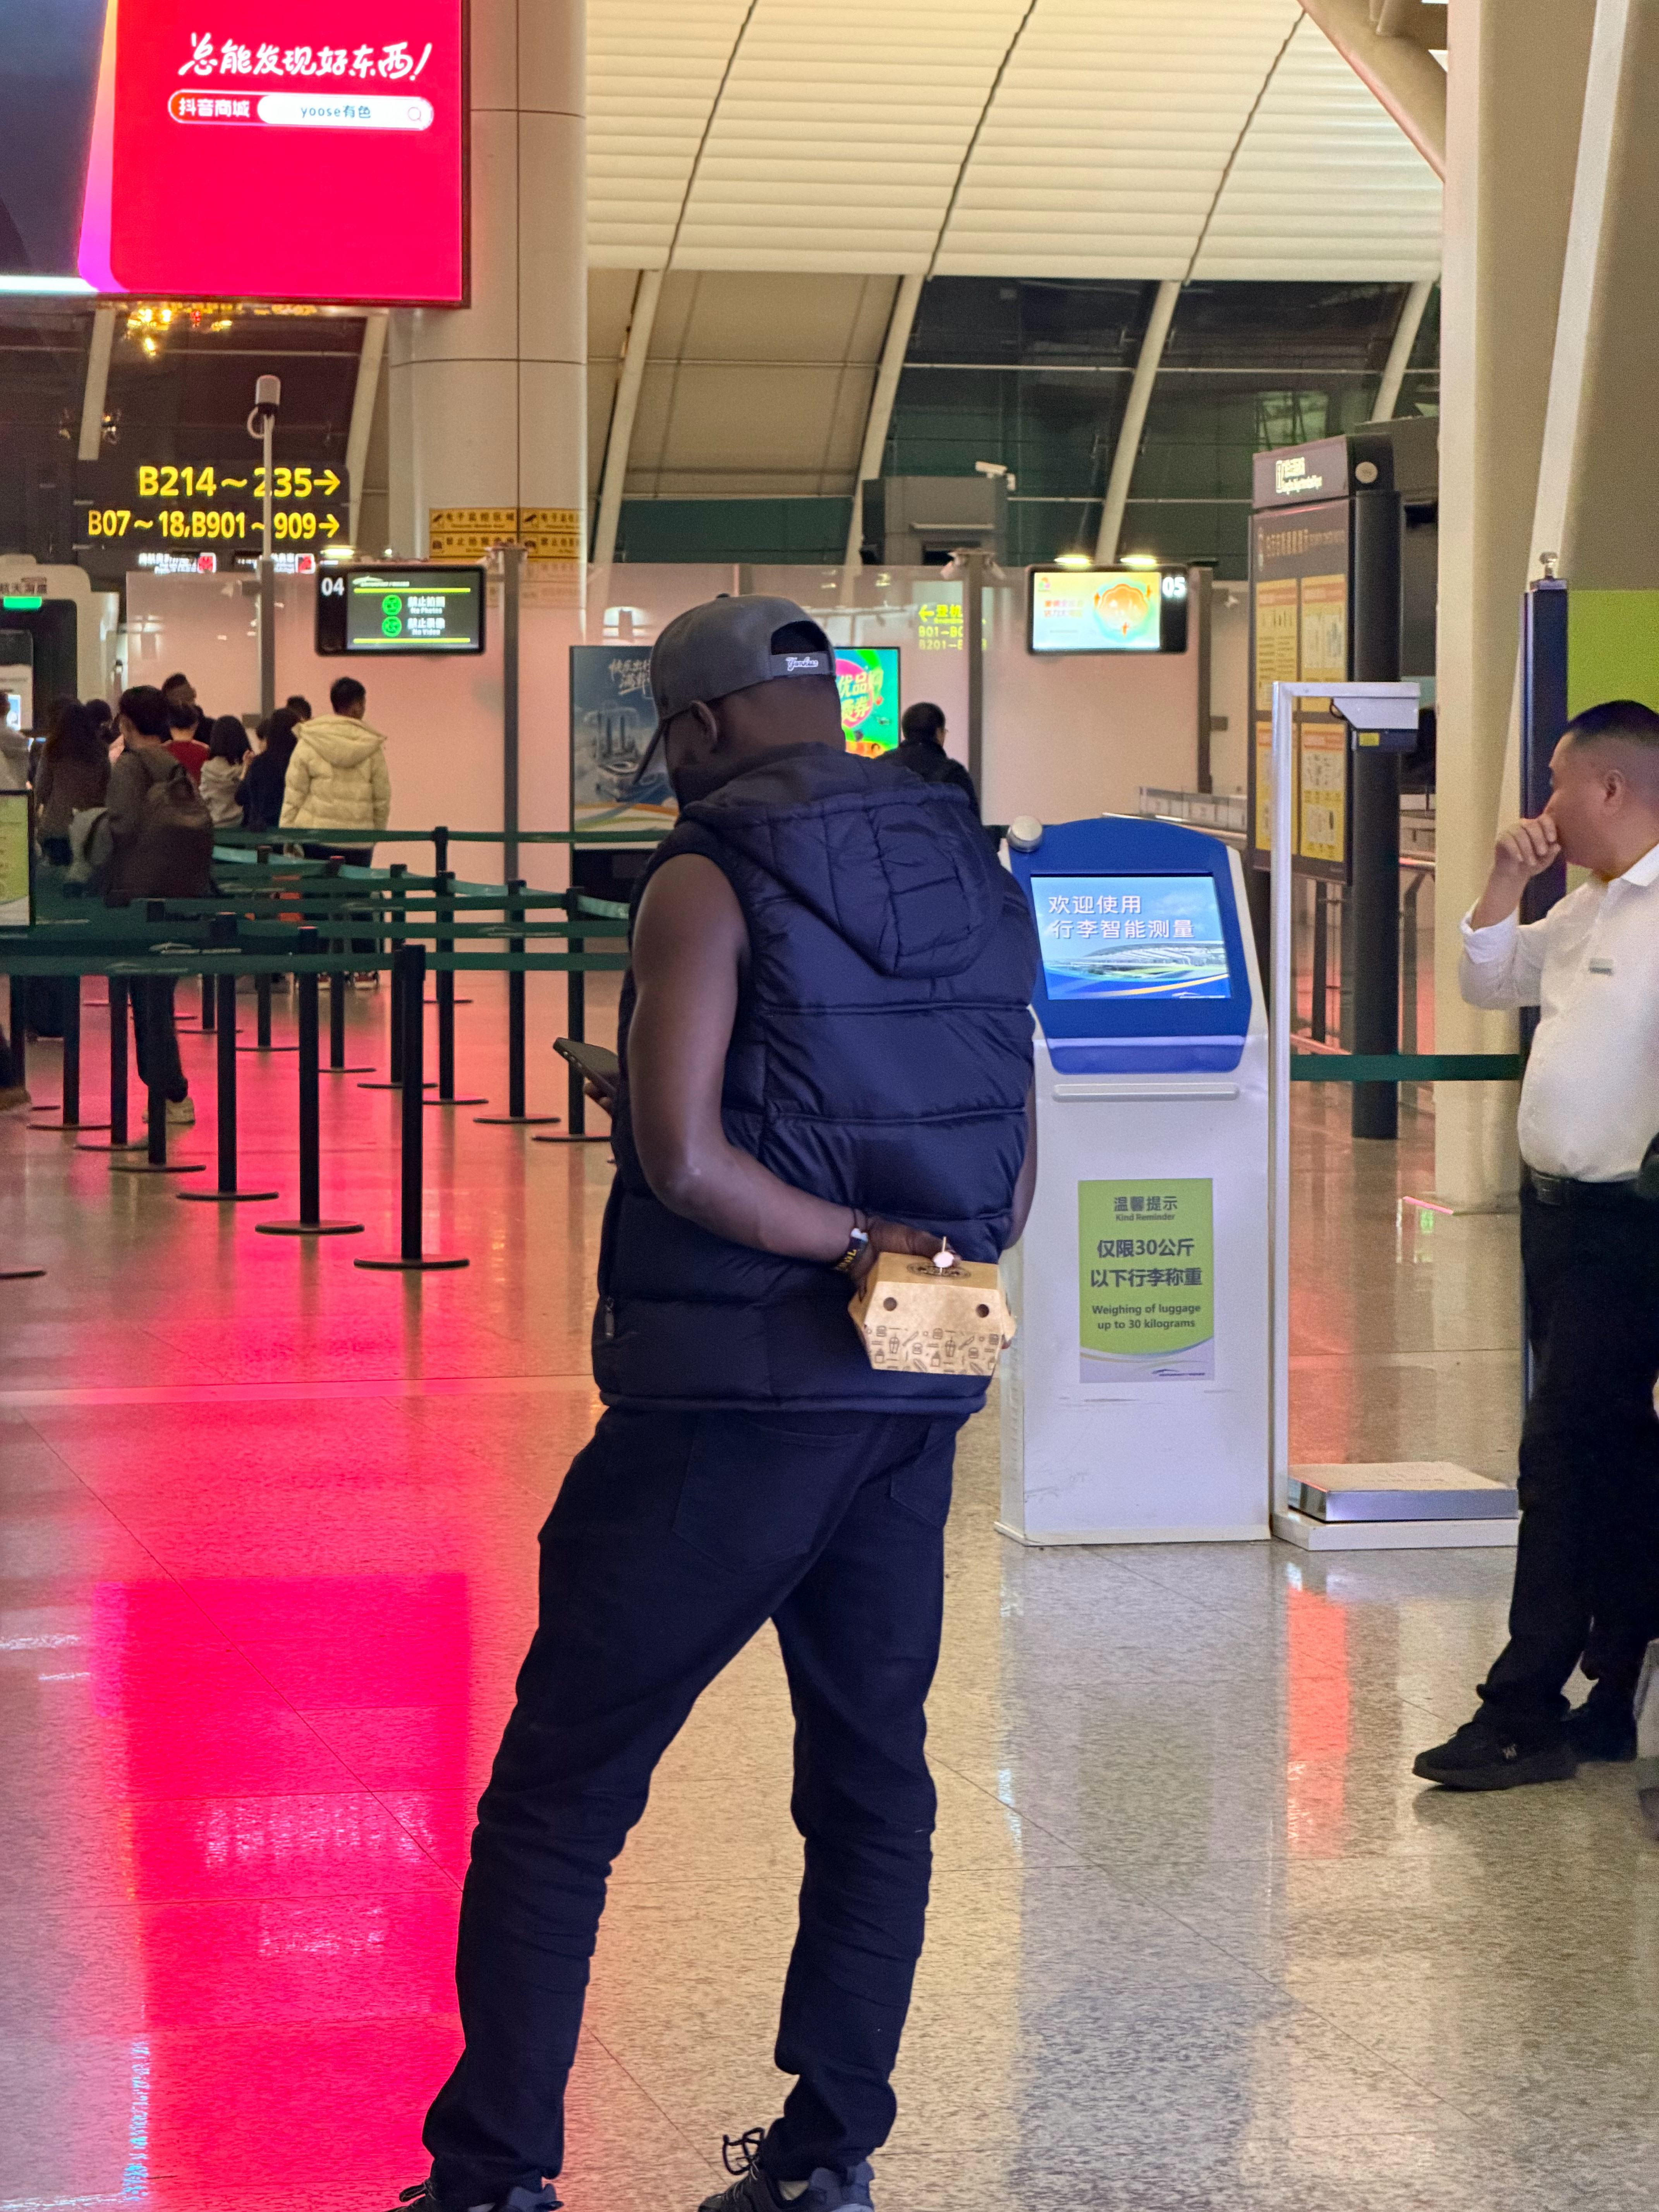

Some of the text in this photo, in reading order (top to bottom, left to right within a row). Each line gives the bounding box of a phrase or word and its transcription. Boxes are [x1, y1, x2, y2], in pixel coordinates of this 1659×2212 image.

[179, 98, 371, 119] 抖音商城 yoose有色
[321, 577, 345, 596] 04
[1162, 576, 1185, 596] 05
[1048, 895, 1142, 914] 欢迎使用
[1053, 919, 1195, 939] 行李智能测量
[1114, 1196, 1178, 1212] 温馨提示
[1097, 1238, 1195, 1258] 仅限30公斤
[1091, 1267, 1202, 1288] 以下行李称重
[1092, 1304, 1200, 1316] Weighing of luggage
[1097, 1319, 1195, 1331] up to 30 kilograms
